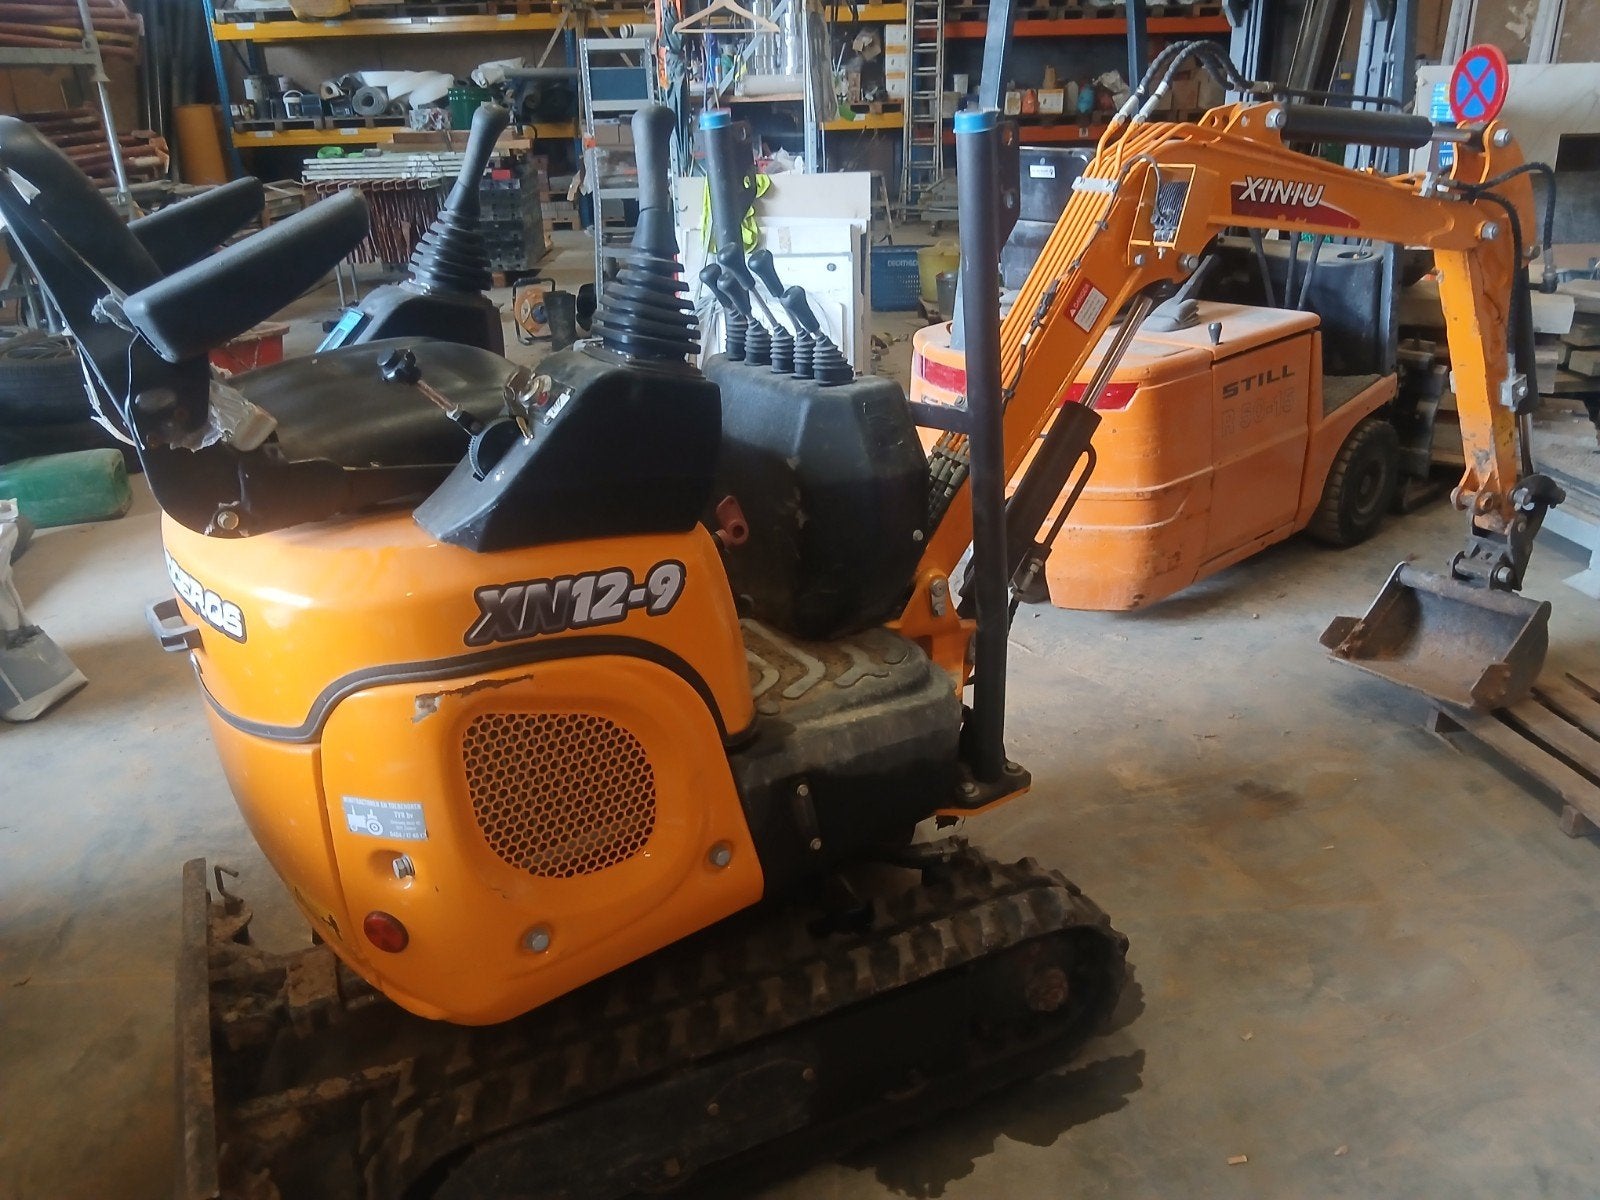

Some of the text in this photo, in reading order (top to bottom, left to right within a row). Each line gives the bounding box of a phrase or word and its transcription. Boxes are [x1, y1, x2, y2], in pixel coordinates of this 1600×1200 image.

[1239, 175, 1325, 208] XINIU
[1222, 365, 1295, 399] STILL
[465, 559, 686, 646] XN12-9
